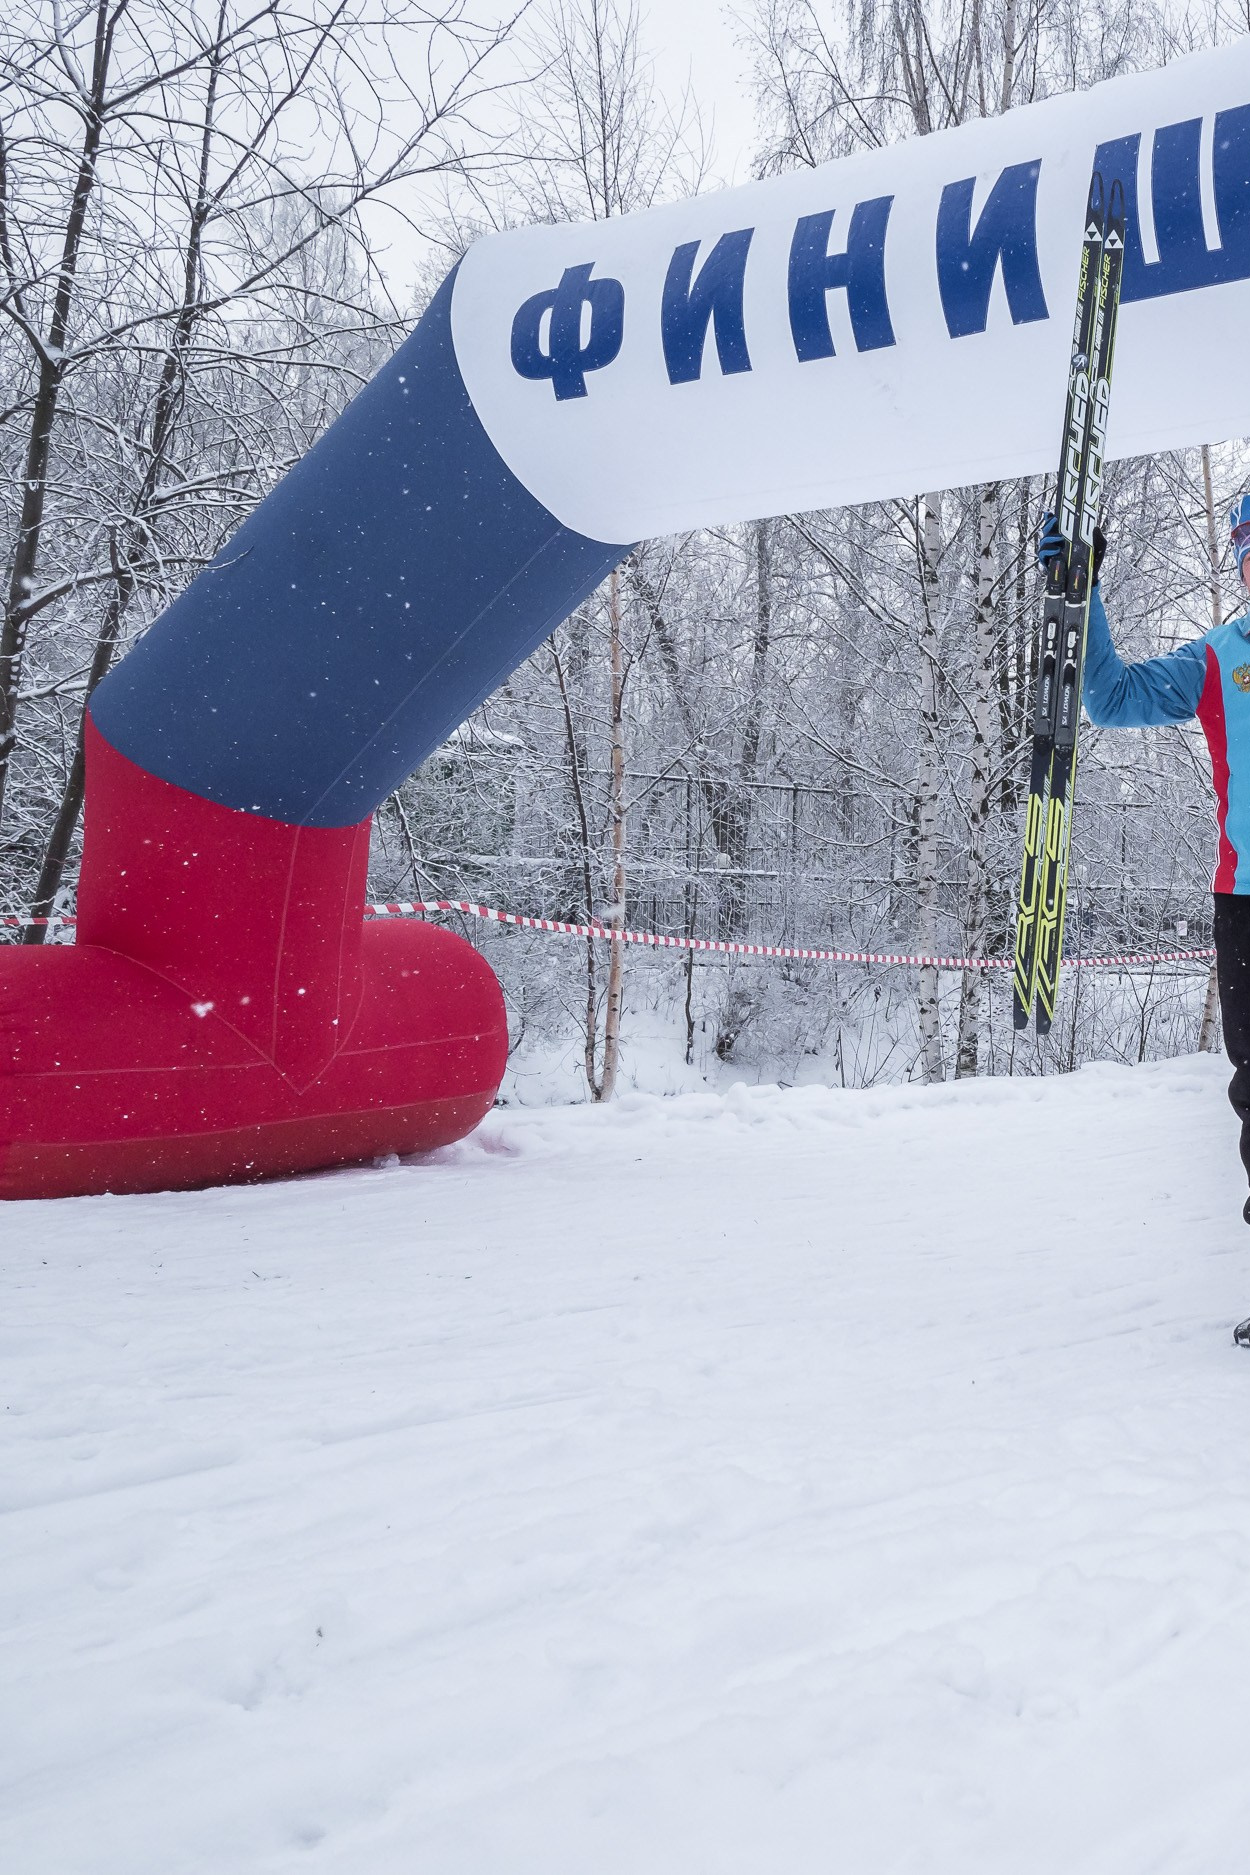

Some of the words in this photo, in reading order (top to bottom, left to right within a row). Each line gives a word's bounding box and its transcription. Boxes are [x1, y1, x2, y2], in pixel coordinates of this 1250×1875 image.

[1078, 246, 1090, 301] FISCHER
[1100, 253, 1112, 309] FISCHER
[1015, 793, 1043, 991] RCS
[1037, 798, 1064, 994] RCS
